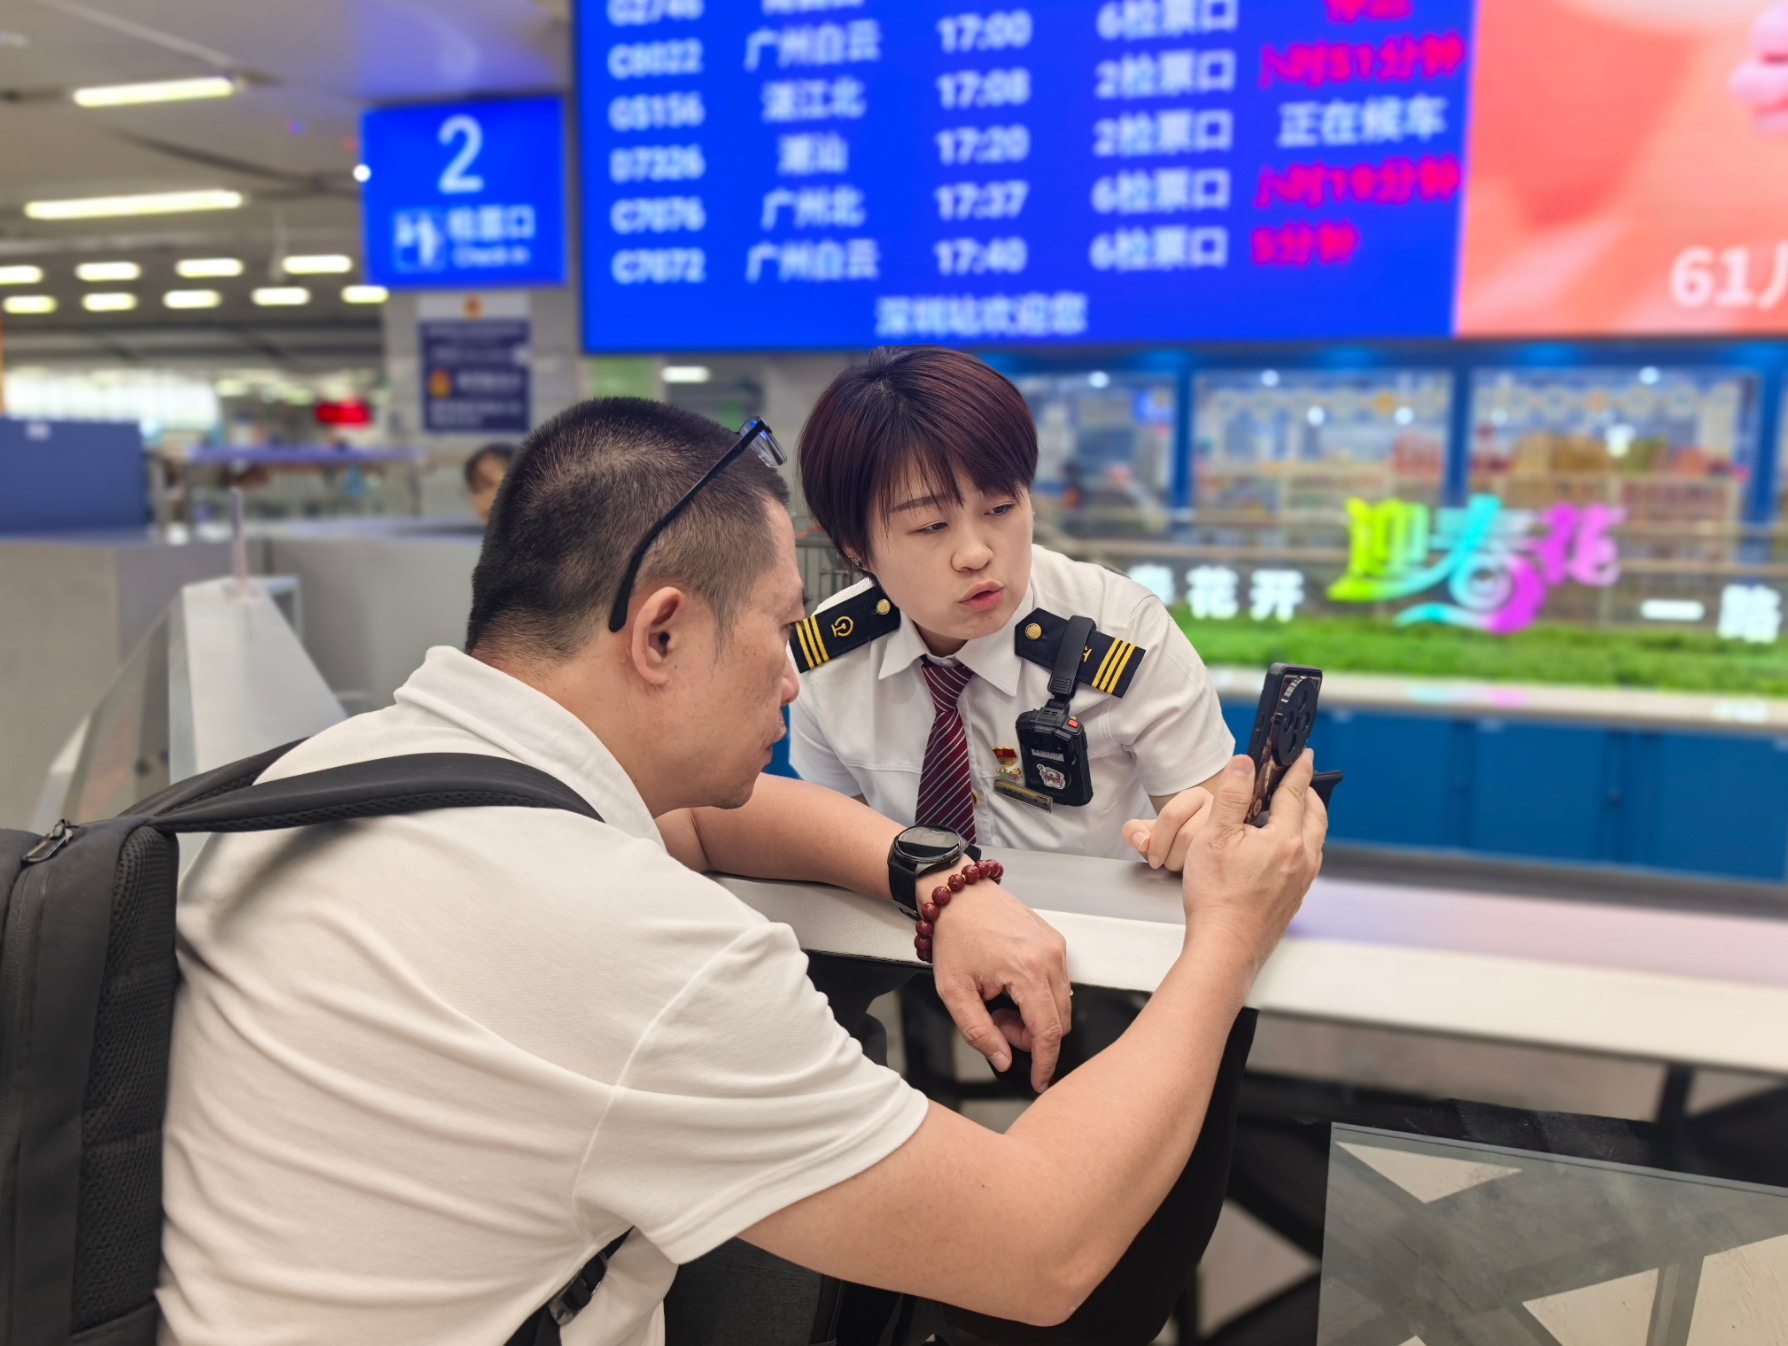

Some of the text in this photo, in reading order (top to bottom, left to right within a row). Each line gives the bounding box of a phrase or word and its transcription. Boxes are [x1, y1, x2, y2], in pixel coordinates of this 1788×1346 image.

[744, 20, 881, 70] 广州白云
[936, 10, 1033, 52] 17:00
[761, 76, 866, 122] 湛江北
[1095, 49, 1237, 98] 2检票口
[437, 115, 485, 194] 2
[1093, 109, 1234, 156] 2检票口
[1277, 94, 1448, 147] 正在候车
[760, 185, 865, 229] 广州北
[934, 180, 1029, 220] 17:37
[1091, 168, 1230, 214] 6检票口
[746, 239, 879, 282] 广州白云
[934, 237, 1027, 275] 17:40
[1089, 225, 1228, 271] 6检票口
[875, 293, 1088, 337] 深圳站欢迎您
